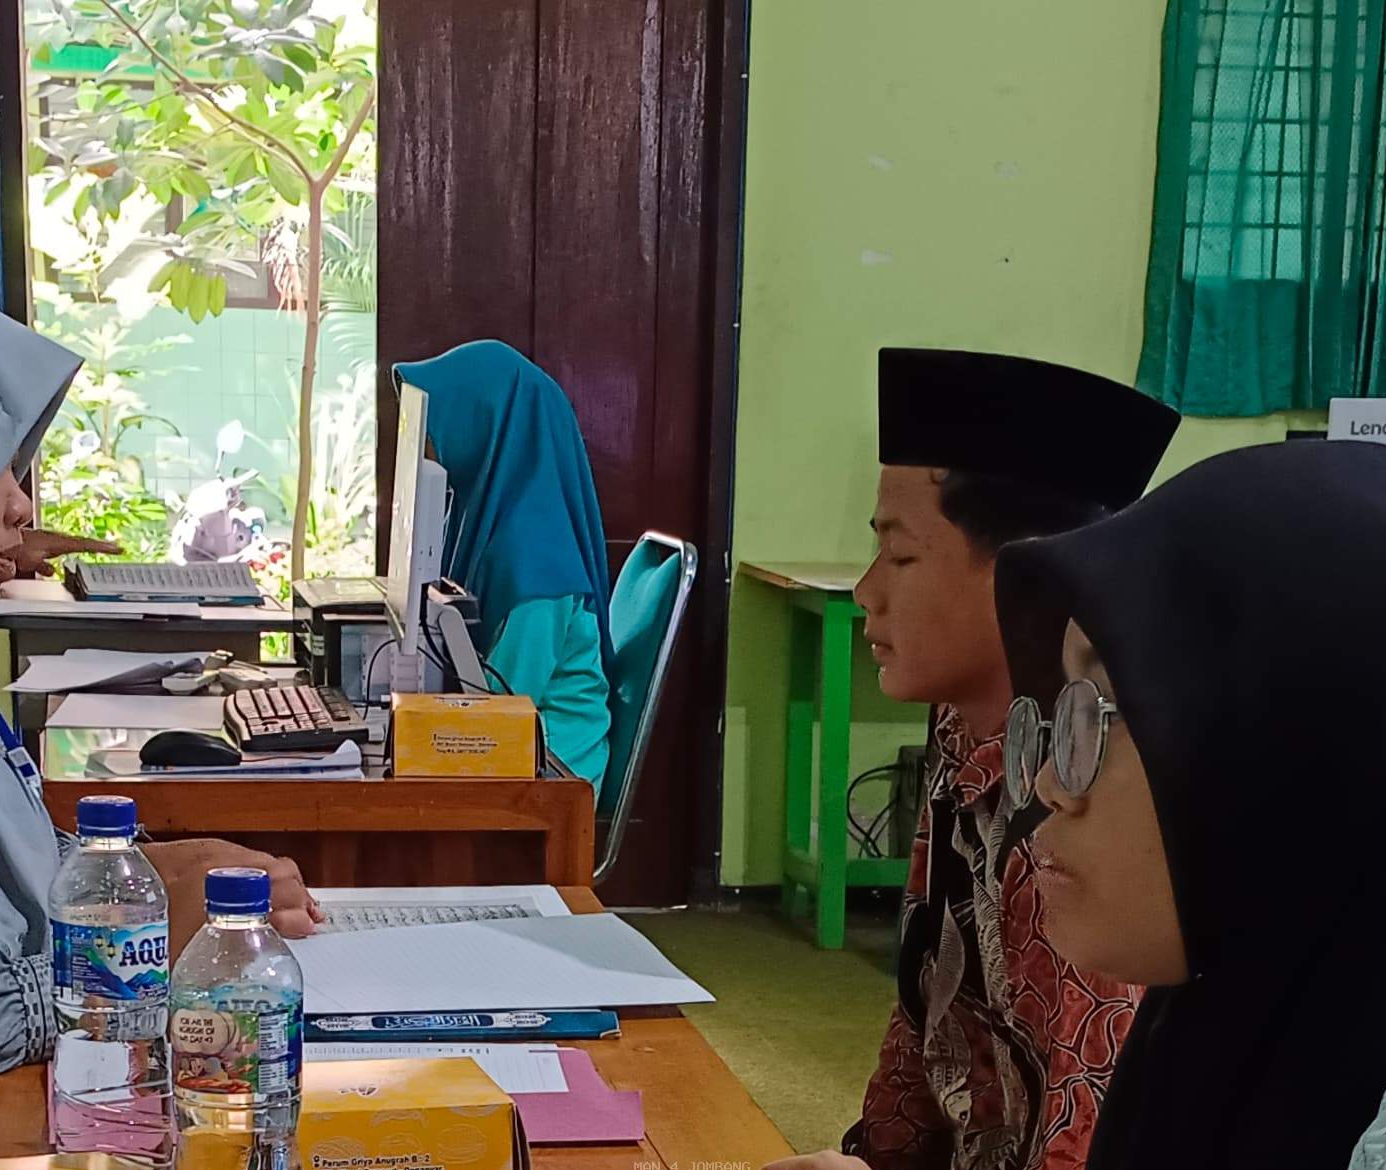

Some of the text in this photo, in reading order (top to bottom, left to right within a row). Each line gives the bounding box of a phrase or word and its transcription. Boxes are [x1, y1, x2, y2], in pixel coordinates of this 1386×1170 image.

[119, 936, 168, 967] AQU
[352, 1158, 373, 1167] Griya
[375, 1155, 410, 1166] Anugrah
[425, 1154, 430, 1162] 2
